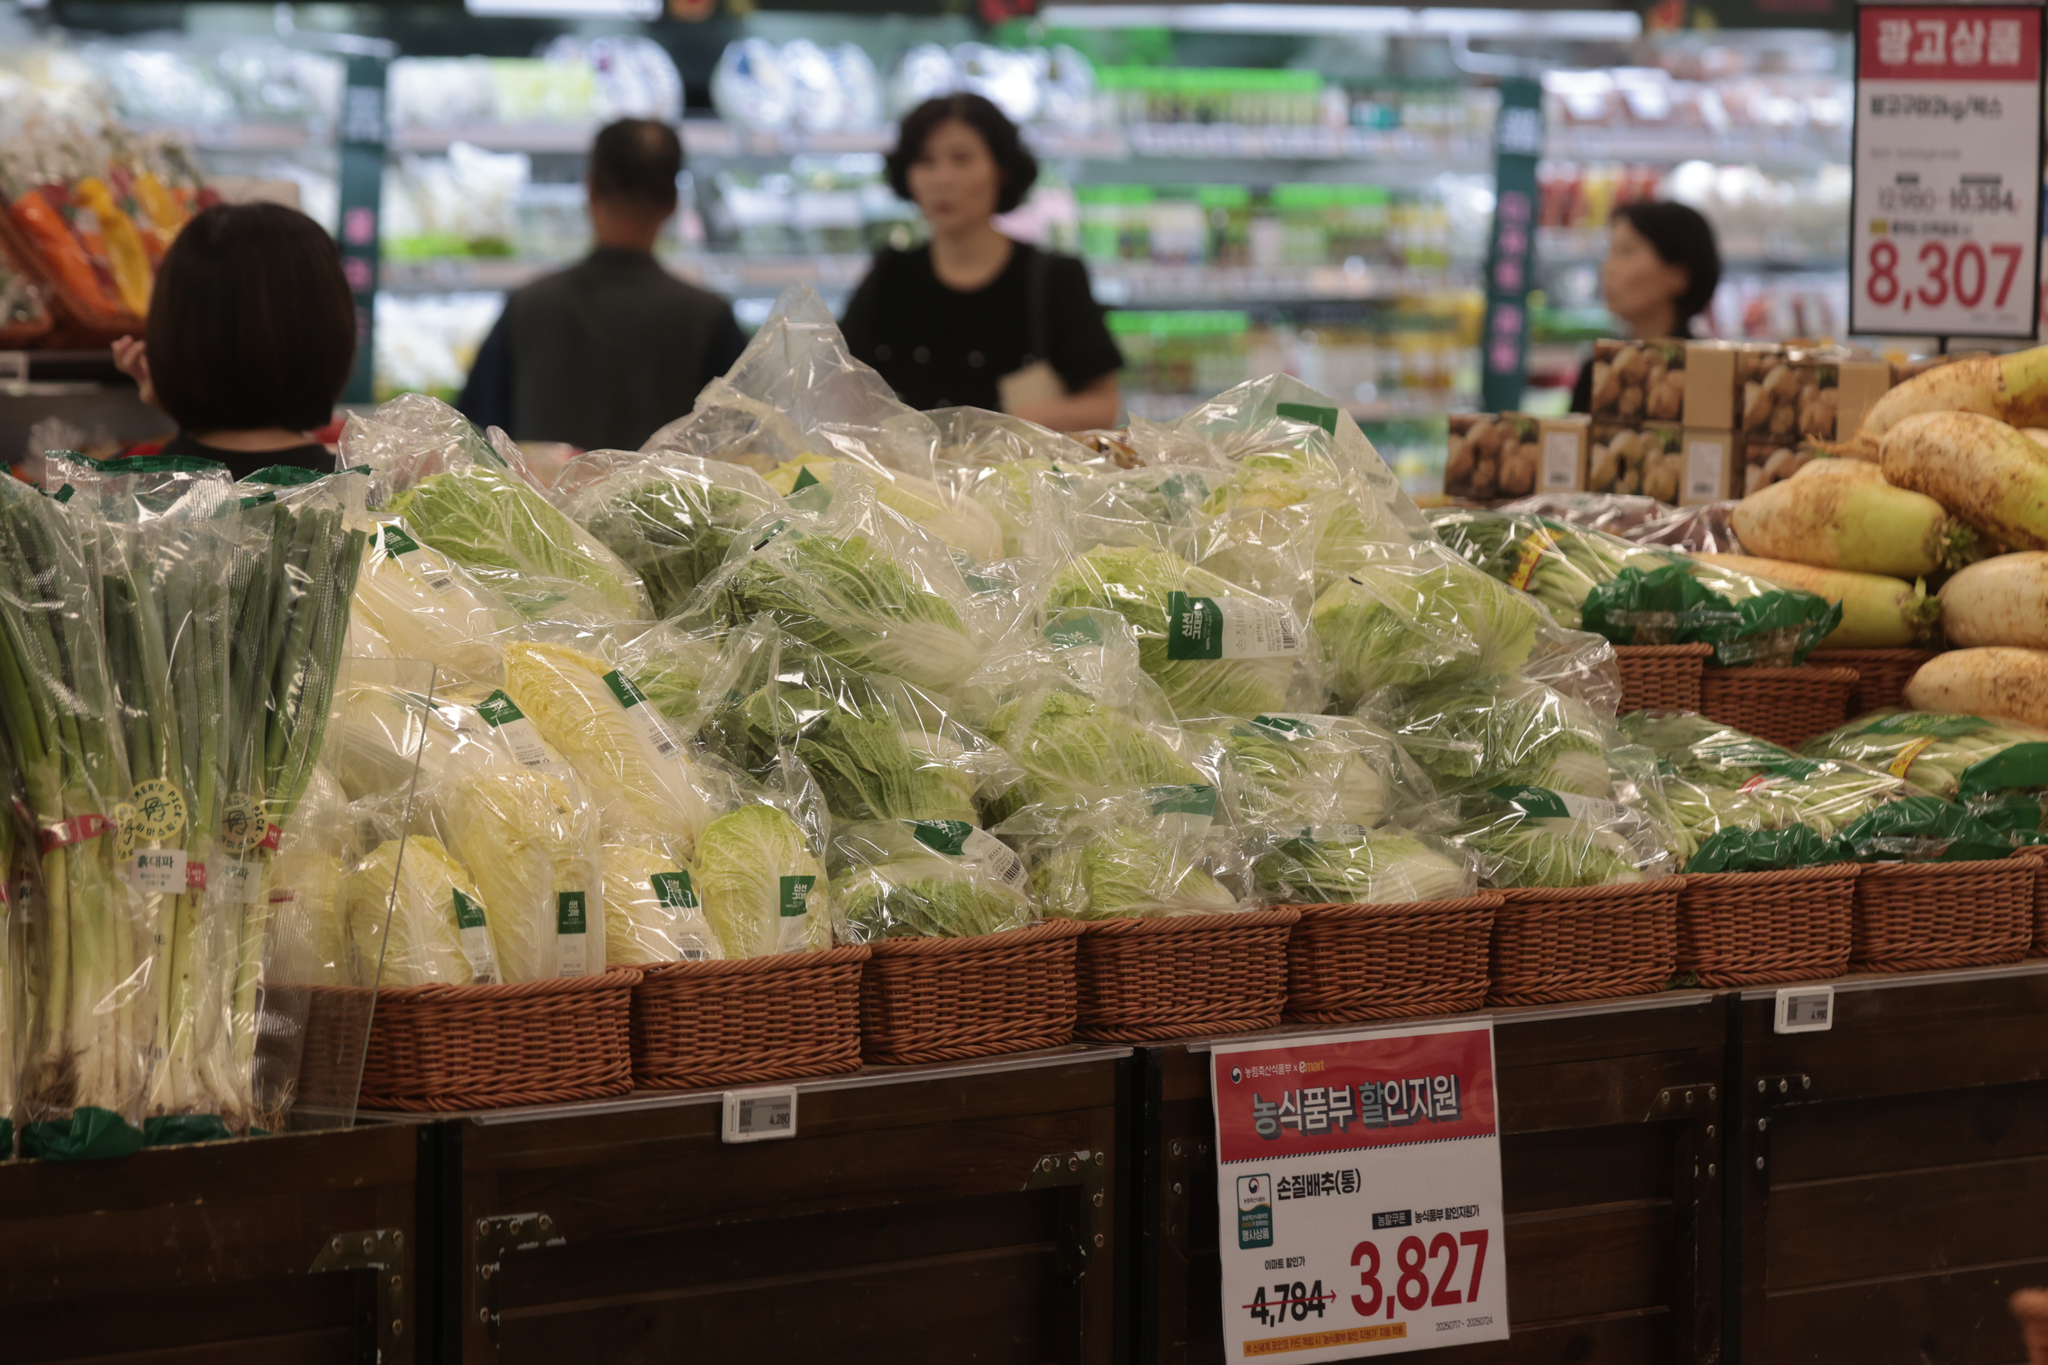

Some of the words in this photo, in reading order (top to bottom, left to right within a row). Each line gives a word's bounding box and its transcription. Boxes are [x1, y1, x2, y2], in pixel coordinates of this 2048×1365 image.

[1878, 18, 2022, 66] 광고상품
[1867, 239, 2023, 312] 8,307
[168, 790, 182, 819] PICK
[254, 805, 265, 832] PICK
[1244, 1063, 1291, 1079] 농림축산식품부
[1299, 1060, 1325, 1073] emart
[1253, 1085, 1353, 1135] 농식품부
[1358, 1074, 1458, 1124] 할인지원
[1277, 1168, 1361, 1201] 손질배추(통)
[1377, 1212, 1406, 1227] 농할쿠폰
[1415, 1209, 1443, 1223] 농식품부
[1444, 1204, 1480, 1220] 할인지원가
[1242, 1228, 1270, 1241] 행사상품
[1265, 1258, 1284, 1270] 이마트
[1286, 1256, 1305, 1268] 할인가
[1351, 1229, 1489, 1319] 3,827
[1251, 1280, 1326, 1327] 4,784
[1253, 1341, 1270, 1353] 신세계
[1272, 1339, 1289, 1350] 포인트
[1290, 1337, 1302, 1348] 카드
